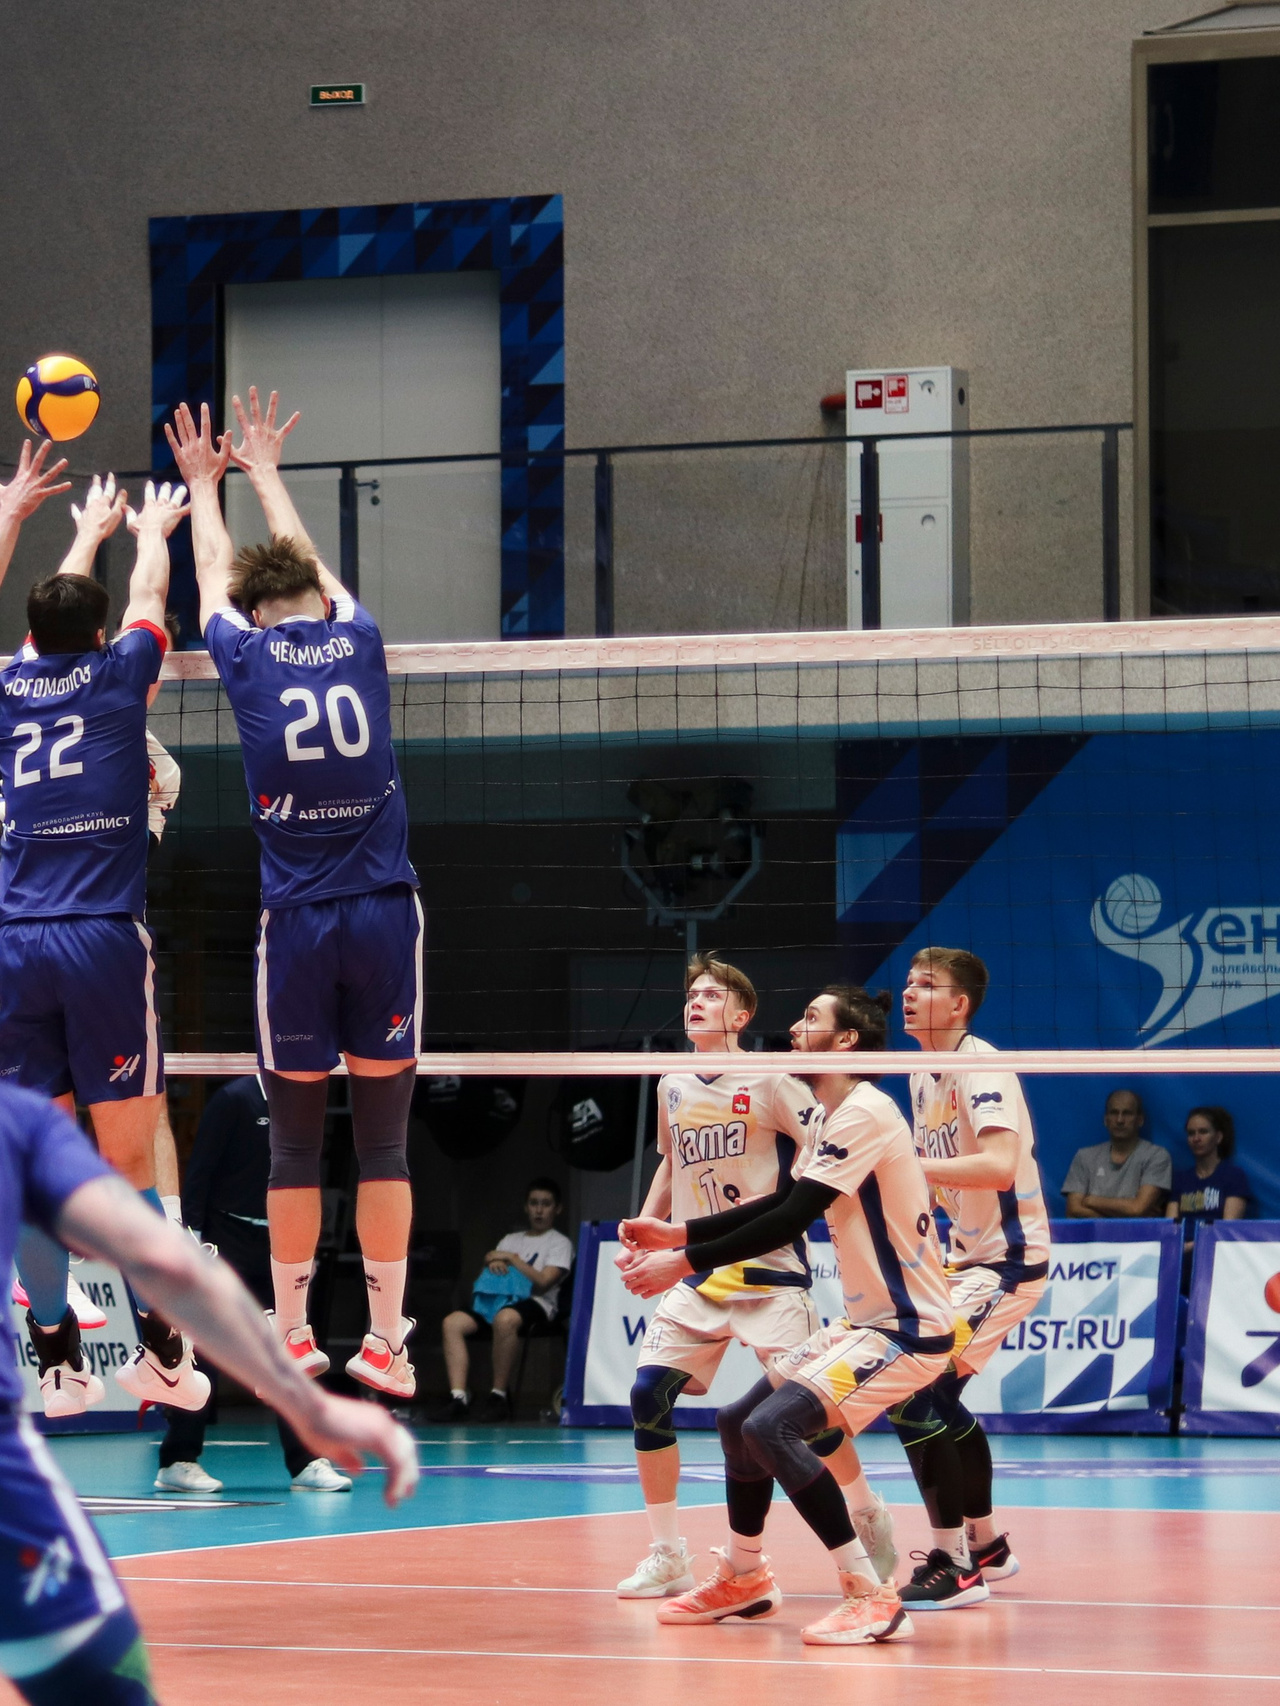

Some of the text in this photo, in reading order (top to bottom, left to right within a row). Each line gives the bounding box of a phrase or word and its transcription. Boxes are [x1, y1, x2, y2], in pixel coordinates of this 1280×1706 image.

[270, 637, 355, 665] ЧЕКМИЗОВ
[12, 714, 84, 788] 22
[279, 684, 370, 762] 20
